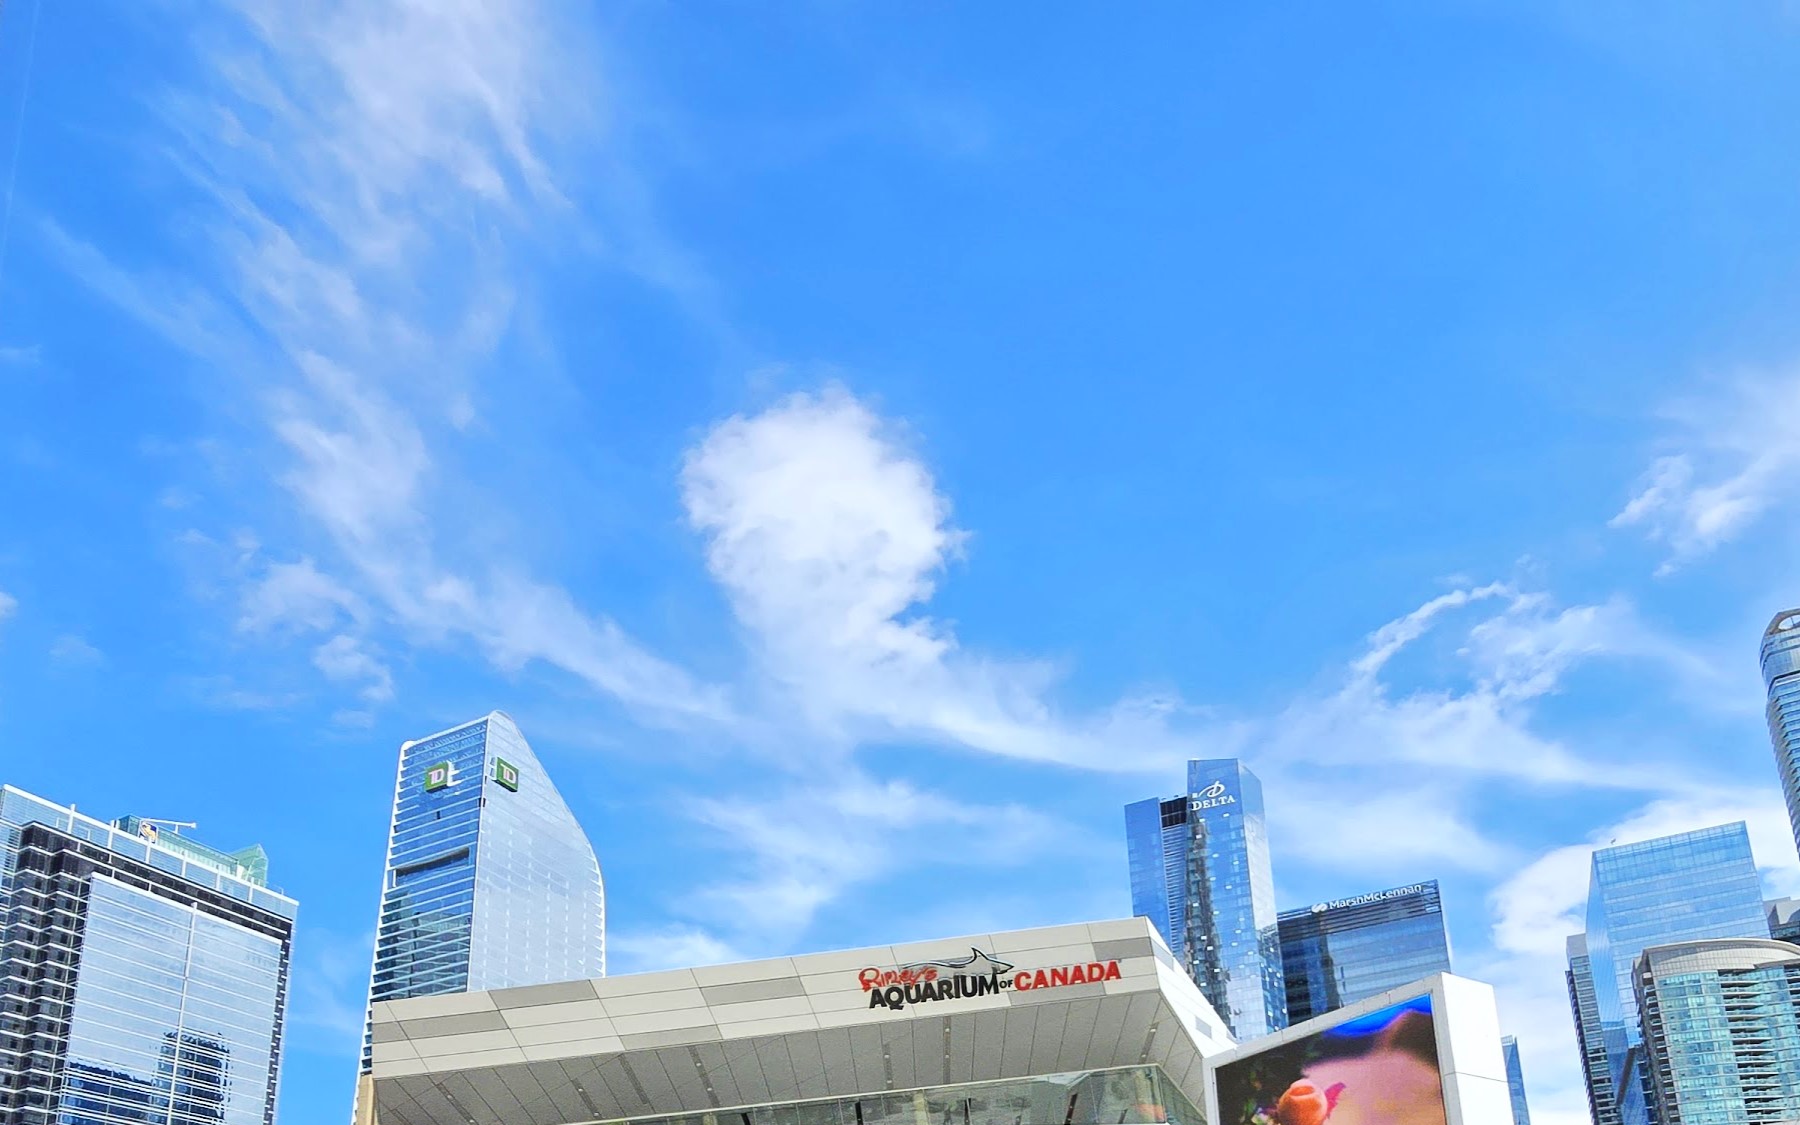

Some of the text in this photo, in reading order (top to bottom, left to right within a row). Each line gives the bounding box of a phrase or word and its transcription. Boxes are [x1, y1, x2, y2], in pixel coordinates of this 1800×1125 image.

[428, 768, 445, 785] TD
[500, 763, 517, 784] TD
[1191, 795, 1236, 811] DELTA
[869, 960, 1121, 1010] AQUARIUM OF CANADA
